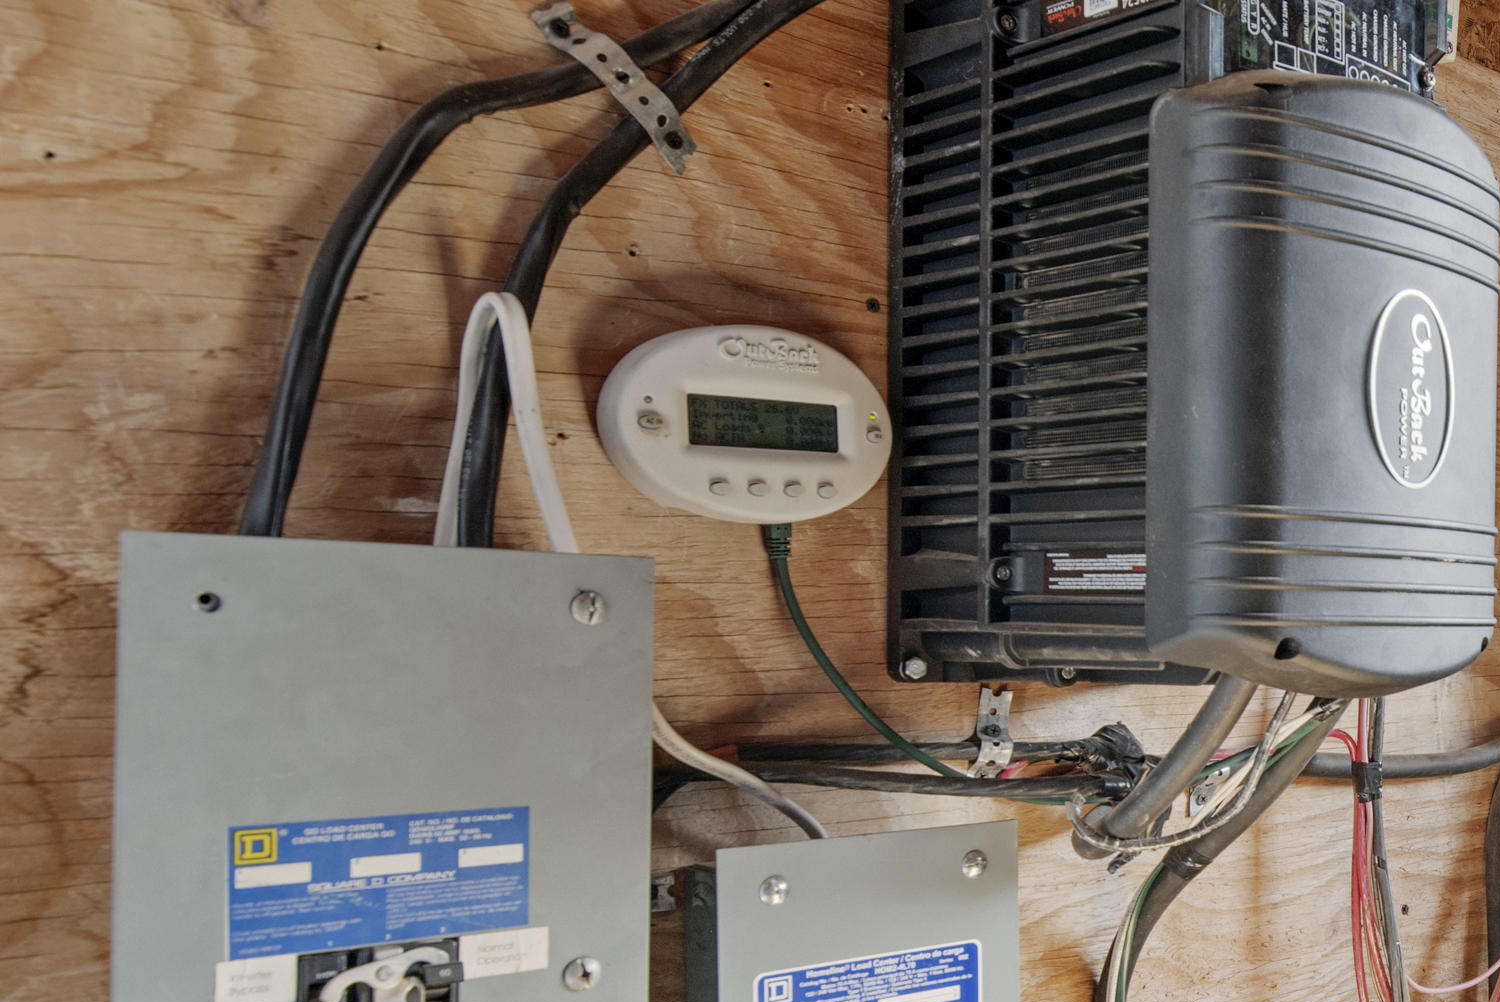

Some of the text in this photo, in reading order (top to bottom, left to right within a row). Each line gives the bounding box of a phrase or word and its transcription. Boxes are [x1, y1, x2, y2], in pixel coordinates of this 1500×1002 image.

[1411, 313, 1433, 463] OutBack
[1399, 387, 1408, 459] POWER
[307, 870, 456, 891] SQUARE D COMPANY
[851, 960, 872, 971] Load
[873, 957, 900, 967] Center
[905, 952, 931, 962] Centro
[932, 950, 942, 958] de
[943, 947, 965, 956] carga
